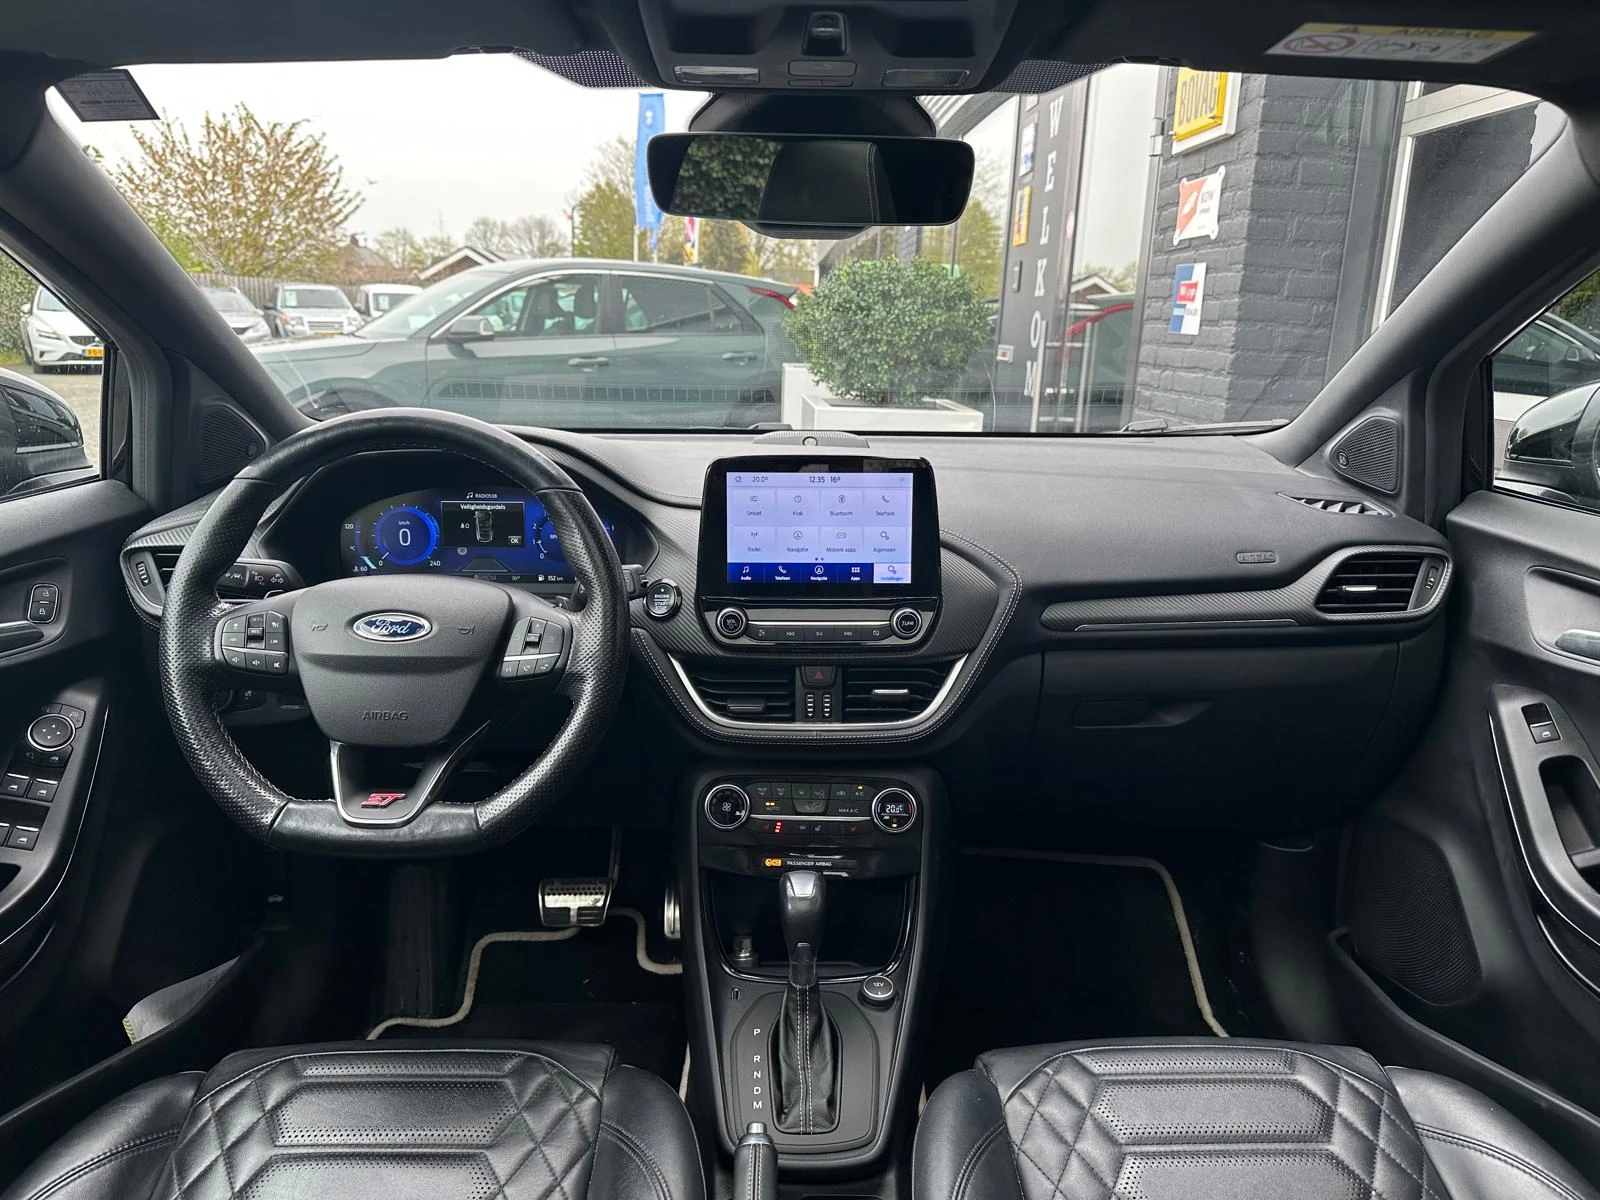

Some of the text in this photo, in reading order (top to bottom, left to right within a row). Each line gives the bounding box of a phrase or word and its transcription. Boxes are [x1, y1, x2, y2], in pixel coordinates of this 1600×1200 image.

[1178, 71, 1219, 128] BOVAG
[399, 528, 411, 546] 0
[786, 546, 809, 554] Navigatie
[873, 546, 896, 554] Algemeen
[362, 710, 409, 721] AIRBAG
[360, 792, 407, 809] ST
[753, 1028, 761, 1036] P
[753, 1055, 761, 1063] R
[753, 1071, 761, 1079] N
[753, 1086, 761, 1094] D
[753, 1101, 762, 1109] M
